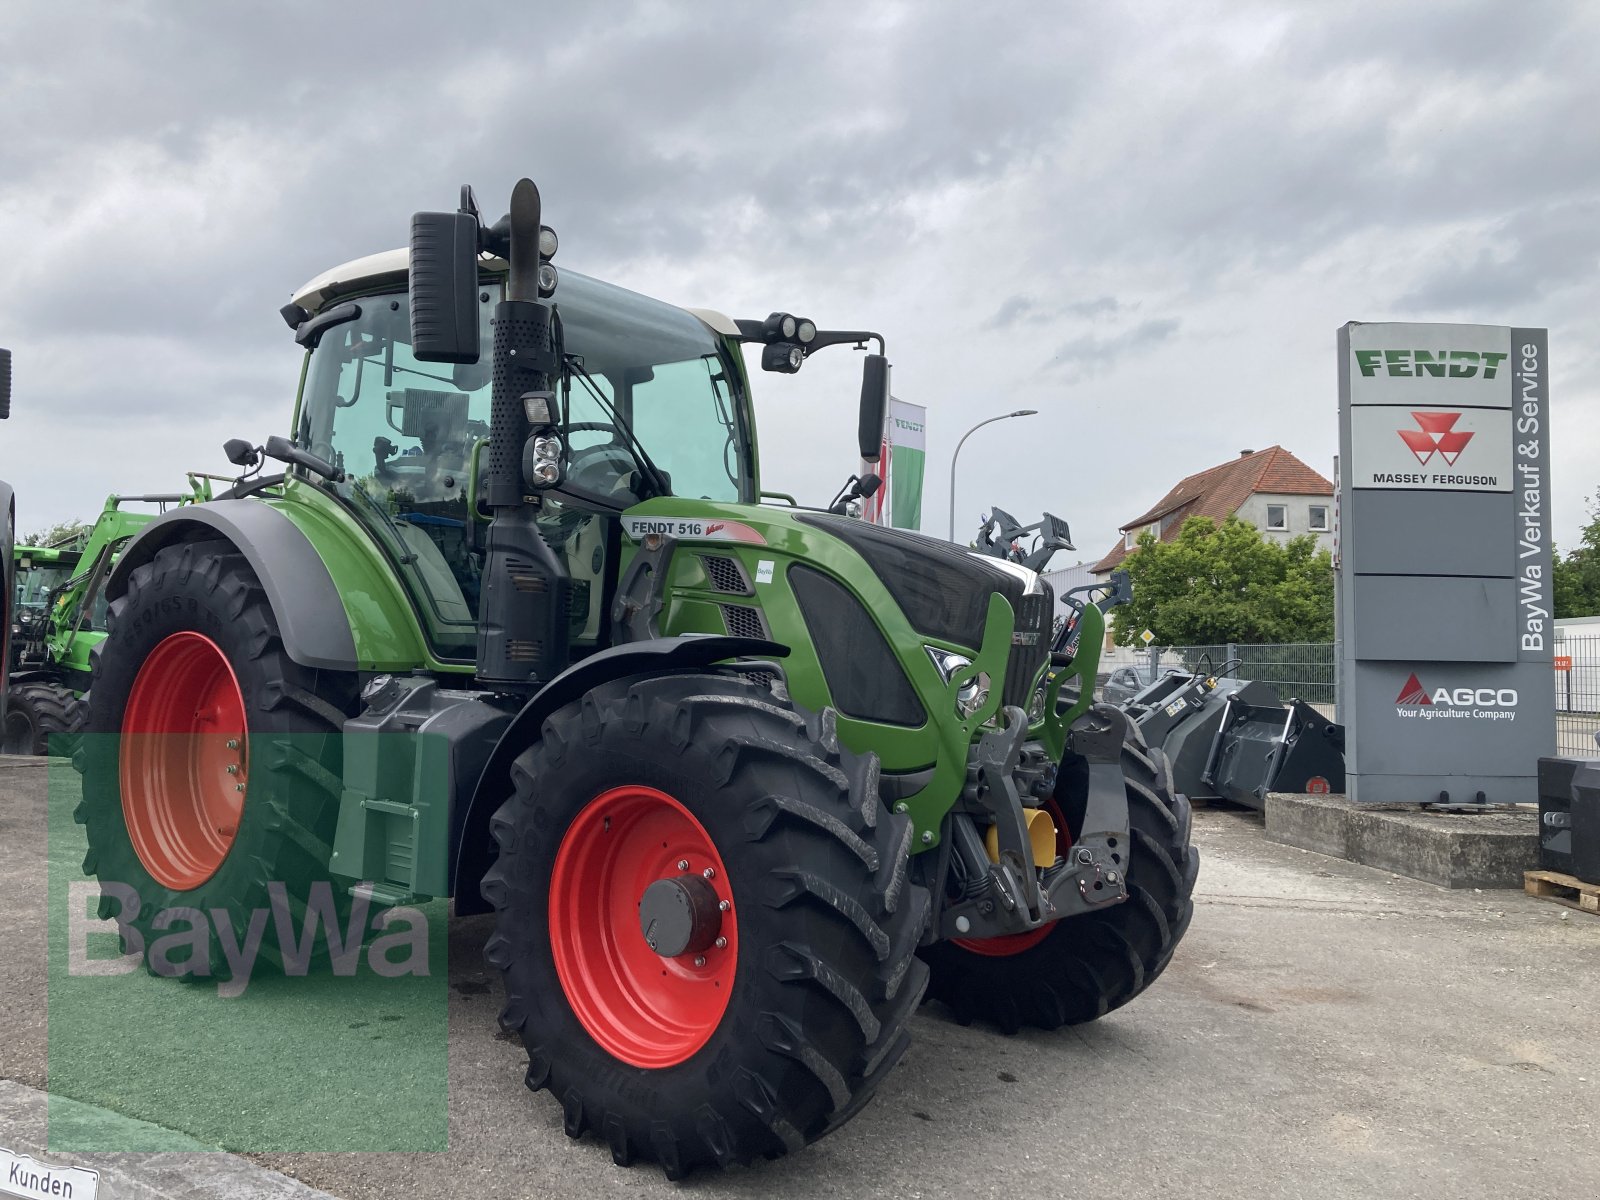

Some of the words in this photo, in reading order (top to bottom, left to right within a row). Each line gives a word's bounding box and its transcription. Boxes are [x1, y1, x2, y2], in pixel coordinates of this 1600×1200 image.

[1355, 350, 1508, 379] FENDT
[1516, 343, 1539, 434] Service
[895, 418, 924, 432] FENDT
[1518, 439, 1539, 458] &
[1373, 473, 1427, 484] MASSEY
[1432, 474, 1497, 486] FERGUSON
[1518, 464, 1541, 559] Verkauf
[632, 522, 674, 534] FENDT
[678, 523, 701, 535] 516
[1521, 565, 1548, 651] BayWa
[1432, 688, 1518, 706] AGCO
[1397, 708, 1417, 718] Your
[1419, 708, 1470, 720] Agriculture
[1473, 709, 1515, 720] Company
[9, 1161, 73, 1199] Kunden
